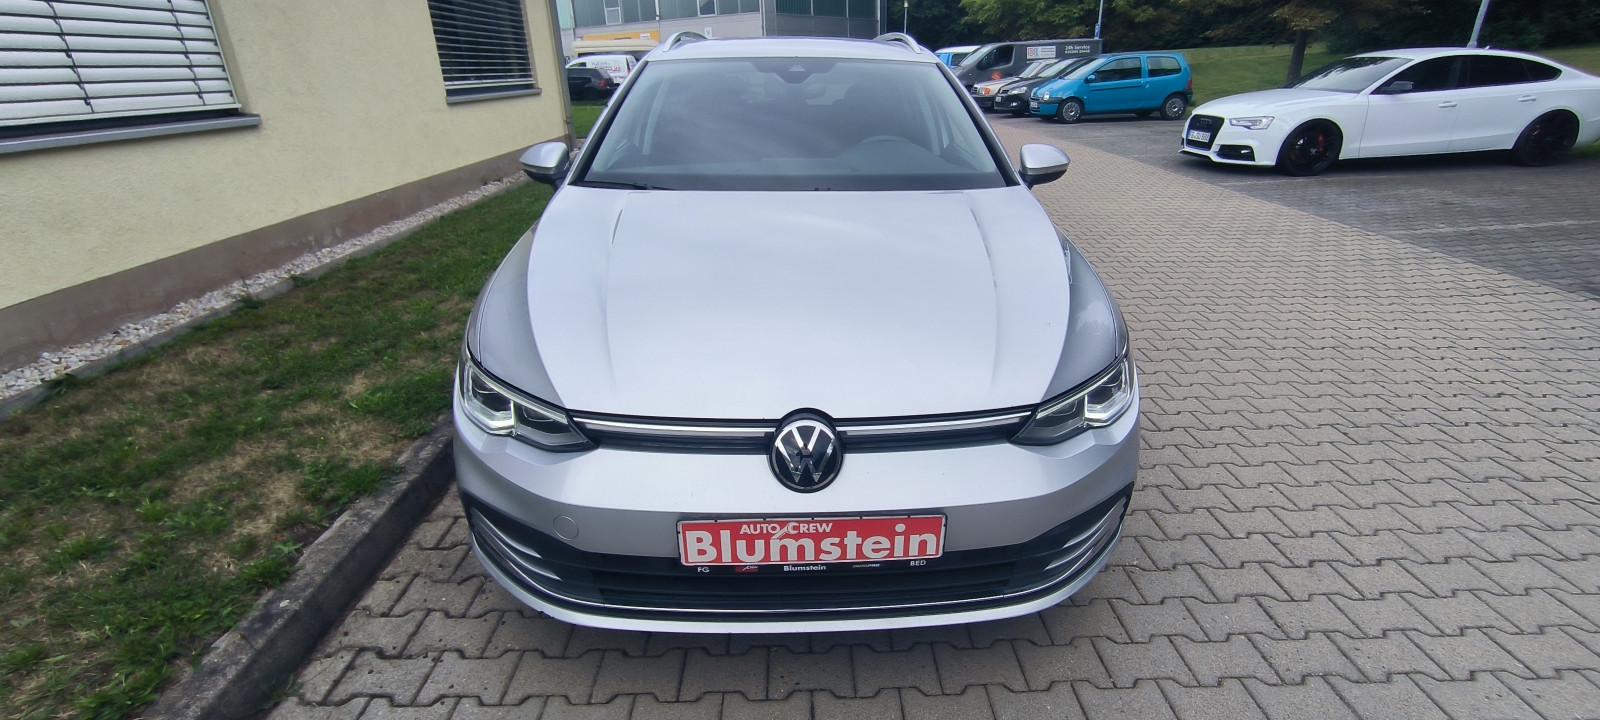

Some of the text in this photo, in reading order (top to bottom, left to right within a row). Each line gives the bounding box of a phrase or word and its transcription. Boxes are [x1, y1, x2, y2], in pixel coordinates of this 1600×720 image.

[739, 521, 833, 535] AUTO CREW
[685, 523, 937, 564] Blumstein
[909, 559, 927, 567] BED
[697, 566, 710, 574] FG
[783, 564, 827, 572] Blumstein
